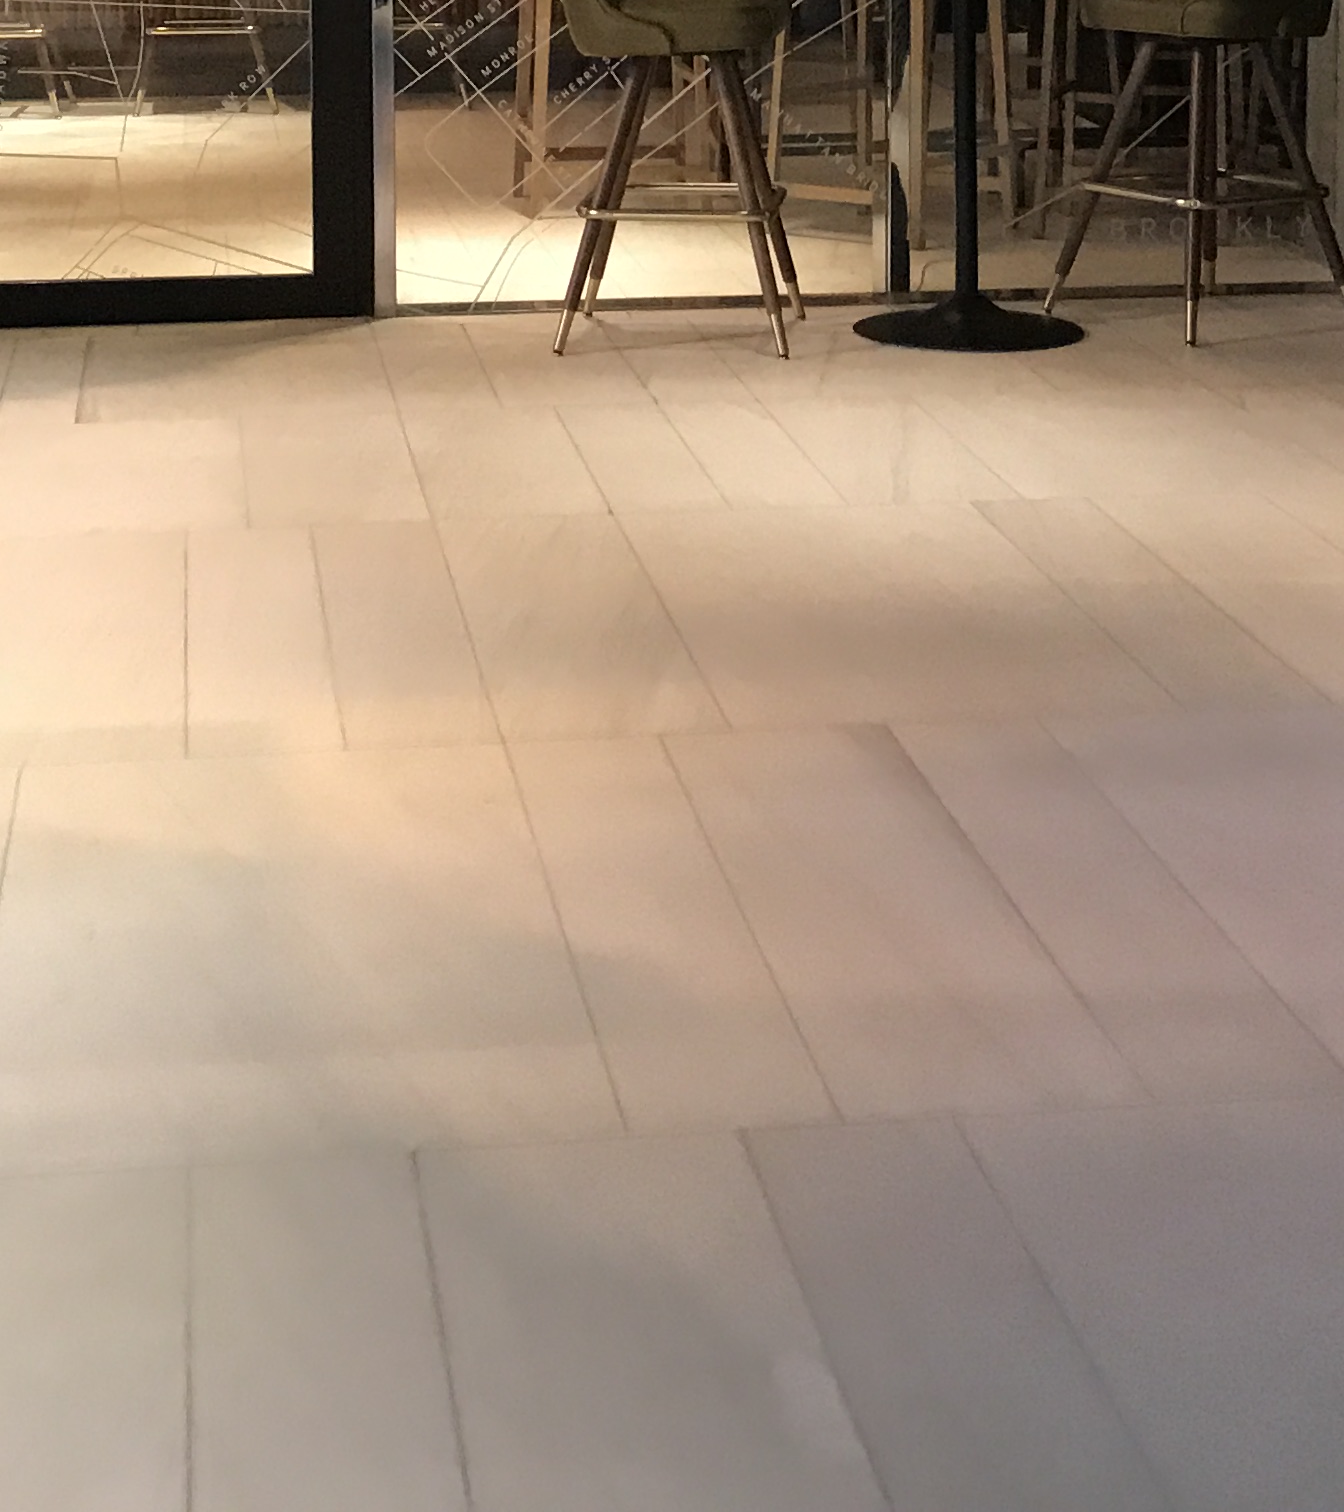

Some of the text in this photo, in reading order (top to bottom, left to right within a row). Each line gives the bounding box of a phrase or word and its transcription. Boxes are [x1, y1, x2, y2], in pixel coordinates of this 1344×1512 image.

[425, 13, 485, 59] MADISON
[480, 33, 535, 78] MONROE
[552, 61, 599, 105] CHERRY
